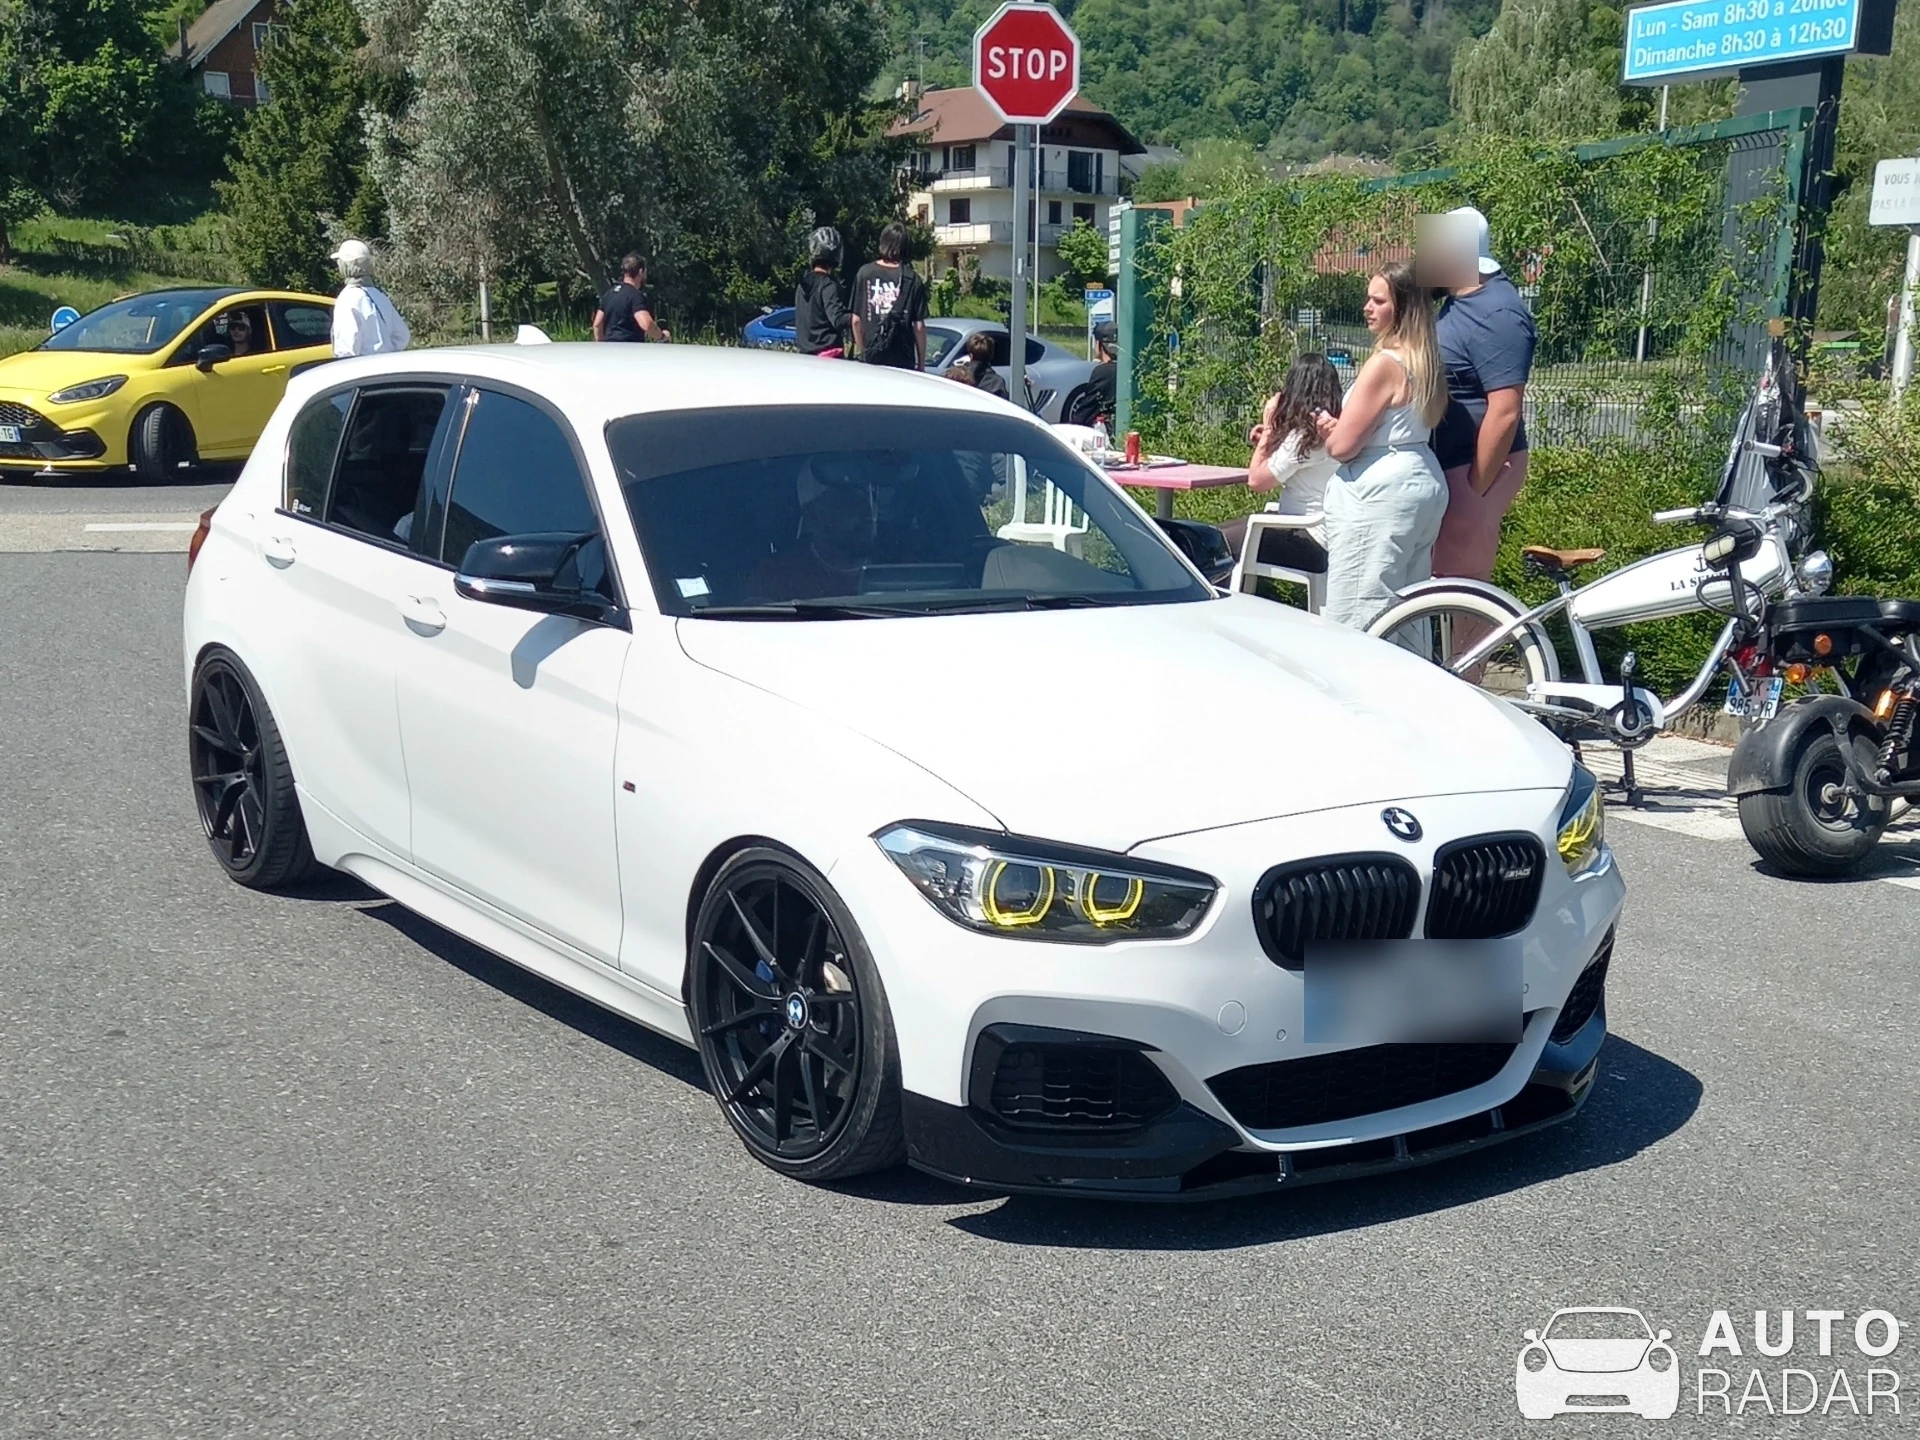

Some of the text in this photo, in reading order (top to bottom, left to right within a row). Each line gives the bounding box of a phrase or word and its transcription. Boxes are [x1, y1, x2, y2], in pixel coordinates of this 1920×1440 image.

[1636, 19, 1667, 39] Lun
[1681, 10, 1719, 31] Sam
[1723, 0, 1769, 25] 8h30
[1634, 17, 1846, 68] Dimanche 8h30 à 12h30
[988, 46, 1067, 81] STOP
[1884, 173, 1910, 186] VOUS
